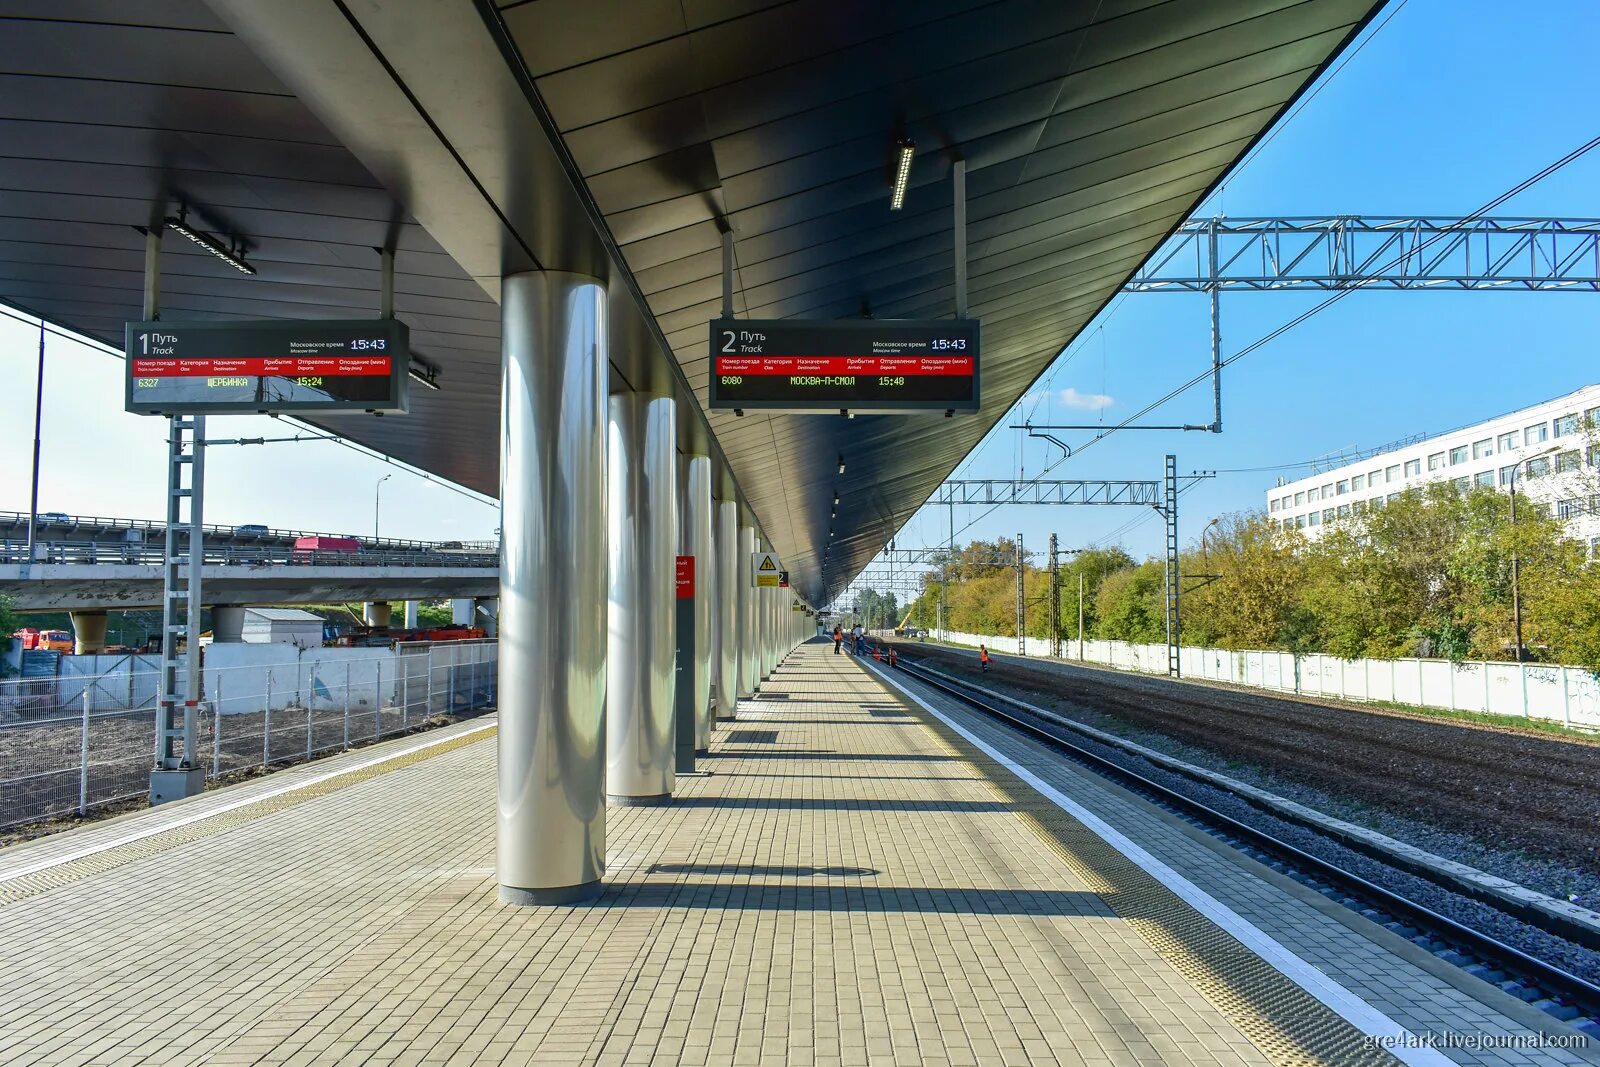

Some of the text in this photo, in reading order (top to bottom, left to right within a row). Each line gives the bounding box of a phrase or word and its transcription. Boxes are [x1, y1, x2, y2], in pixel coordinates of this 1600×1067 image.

[152, 333, 178, 345] Путь
[722, 331, 736, 352] 2
[740, 331, 766, 343] Путь
[139, 333, 149, 355] 1
[326, 342, 344, 350] время
[350, 340, 385, 350] 15:43
[741, 345, 763, 353] Track
[931, 340, 966, 350] 15:43
[152, 347, 175, 355] Track
[138, 379, 159, 388] 6327
[207, 378, 248, 388] ЩЕРБИНКА
[296, 377, 322, 386] 15:24
[721, 376, 743, 385] 6080
[790, 376, 855, 386] МОСКВА-П-СМОЛ
[879, 376, 905, 386] 15:48
